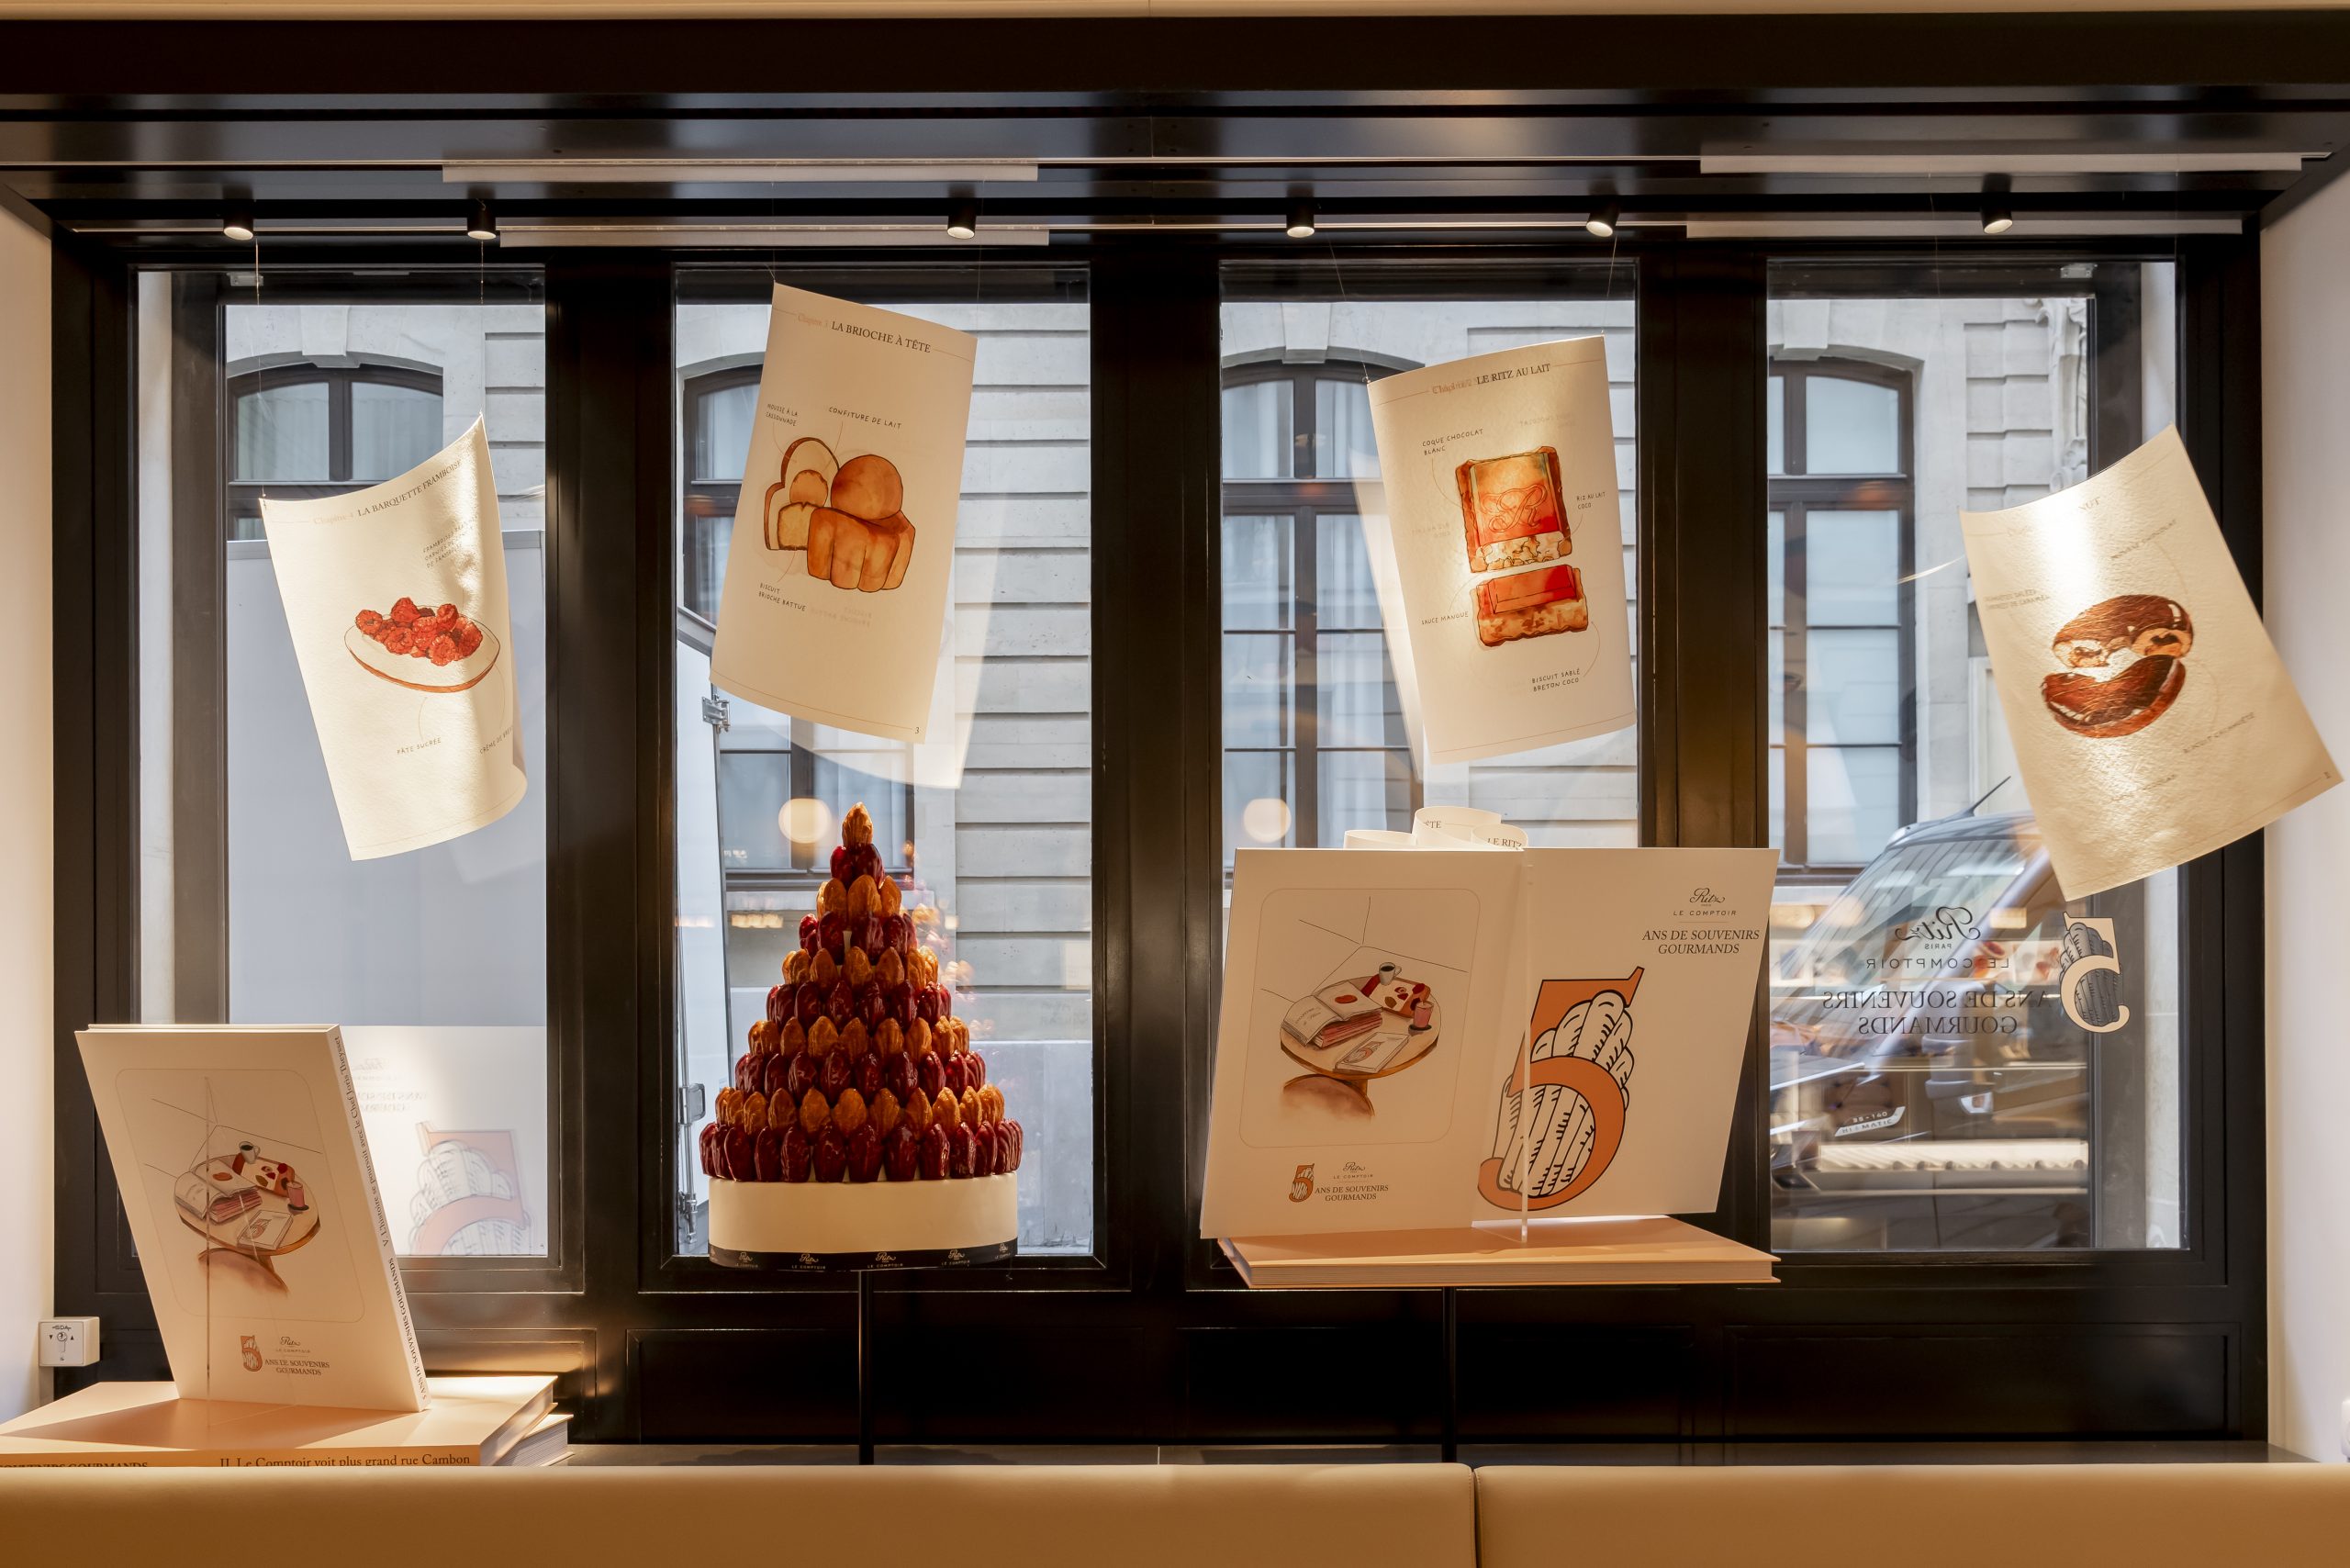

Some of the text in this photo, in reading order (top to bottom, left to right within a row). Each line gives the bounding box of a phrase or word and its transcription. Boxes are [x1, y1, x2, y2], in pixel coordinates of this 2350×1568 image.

[831, 320, 844, 331] LA
[845, 324, 894, 344] BRIOCHE
[895, 334, 903, 346] À
[1476, 375, 1489, 385] LE
[1492, 370, 1514, 382] RITZ
[1516, 367, 1528, 377] AU
[1530, 364, 1551, 375] LAIT
[828, 407, 902, 430] CONFITURE DE LAIT
[1422, 429, 1483, 447] COQUE CHOCOLAT
[1424, 446, 1446, 456] BLANC
[357, 506, 370, 517] LA
[372, 485, 422, 512] BARQUETTE
[759, 582, 780, 595] BISCUIT
[781, 599, 807, 612] BATTUE
[1531, 673, 1558, 684] BISCUIT
[1533, 677, 1579, 692] BRETON COCO
[914, 726, 920, 734] 3
[1689, 887, 1726, 903] Ritz
[1641, 929, 1760, 941] ANS DE SOUVENIRS
[1658, 944, 1740, 955] GOURMANDS
[334, 1036, 347, 1074] Theysset
[343, 1074, 353, 1095] Joris
[346, 1096, 358, 1119] Chef
[353, 1118, 361, 1128] le
[357, 1129, 365, 1148] avec
[362, 1149, 376, 1183] poursuit
[371, 1185, 376, 1194] se
[1315, 1186, 1331, 1194] ANS
[1345, 1184, 1389, 1193] SOUVENIRS
[1325, 1193, 1377, 1202] GOURMANDS
[388, 1257, 406, 1316] GOURMANDS
[402, 1315, 418, 1363] SOUVENIRS
[275, 1367, 322, 1376] GOURMANDS
[289, 1360, 330, 1369] SOUVENIRS
[236, 1457, 252, 1467] Le
[255, 1457, 312, 1467] Comptoir
[314, 1457, 335, 1467] voit
[339, 1455, 362, 1466] plus
[365, 1454, 397, 1466] grand
[400, 1456, 419, 1465] rue
[421, 1453, 470, 1466] Cambon
